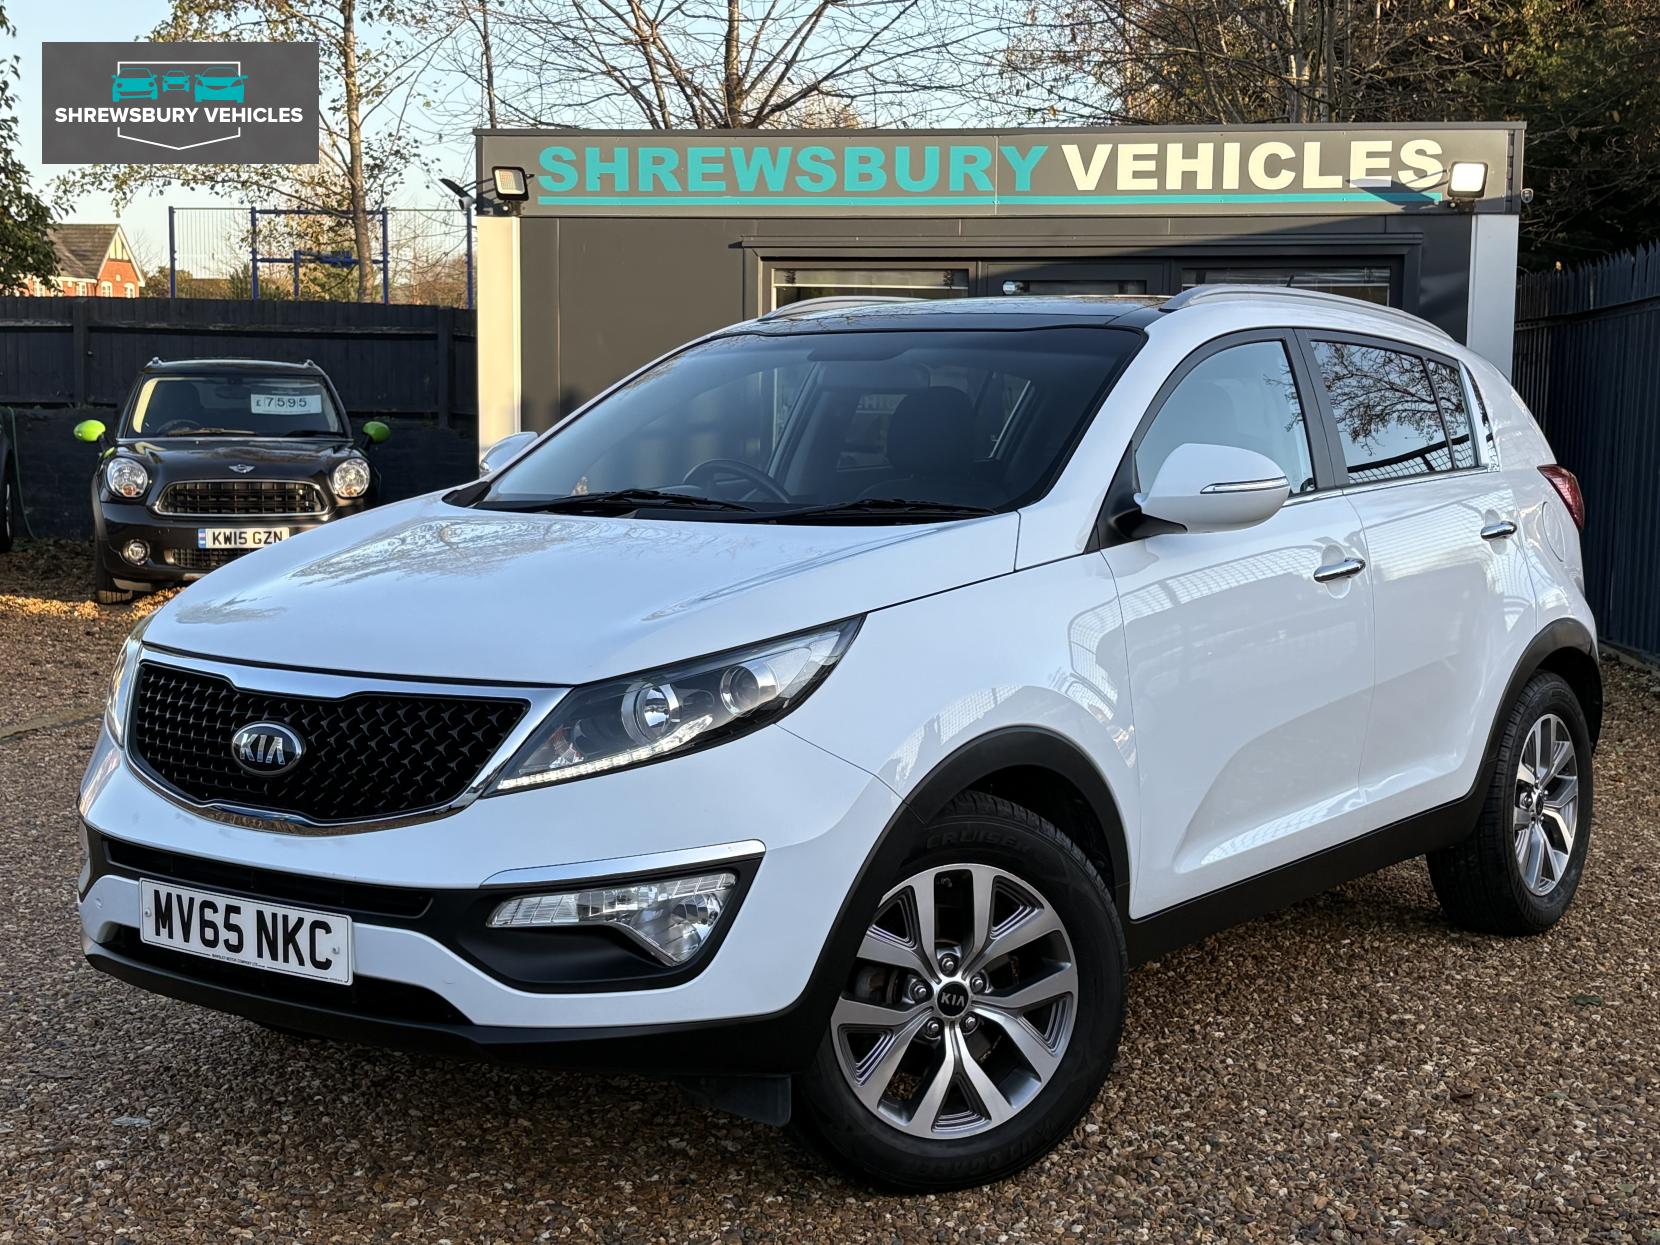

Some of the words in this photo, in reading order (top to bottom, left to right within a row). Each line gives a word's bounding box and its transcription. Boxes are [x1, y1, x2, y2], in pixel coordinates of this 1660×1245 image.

[537, 144, 1049, 193] SHREWSBURY
[1061, 138, 1445, 192] VEHICLES
[212, 531, 248, 546] KW15
[252, 531, 283, 545] GZN
[240, 733, 286, 765] KIA
[153, 889, 244, 954] MV65
[256, 909, 333, 971] NKC
[940, 991, 965, 1008] KIA
